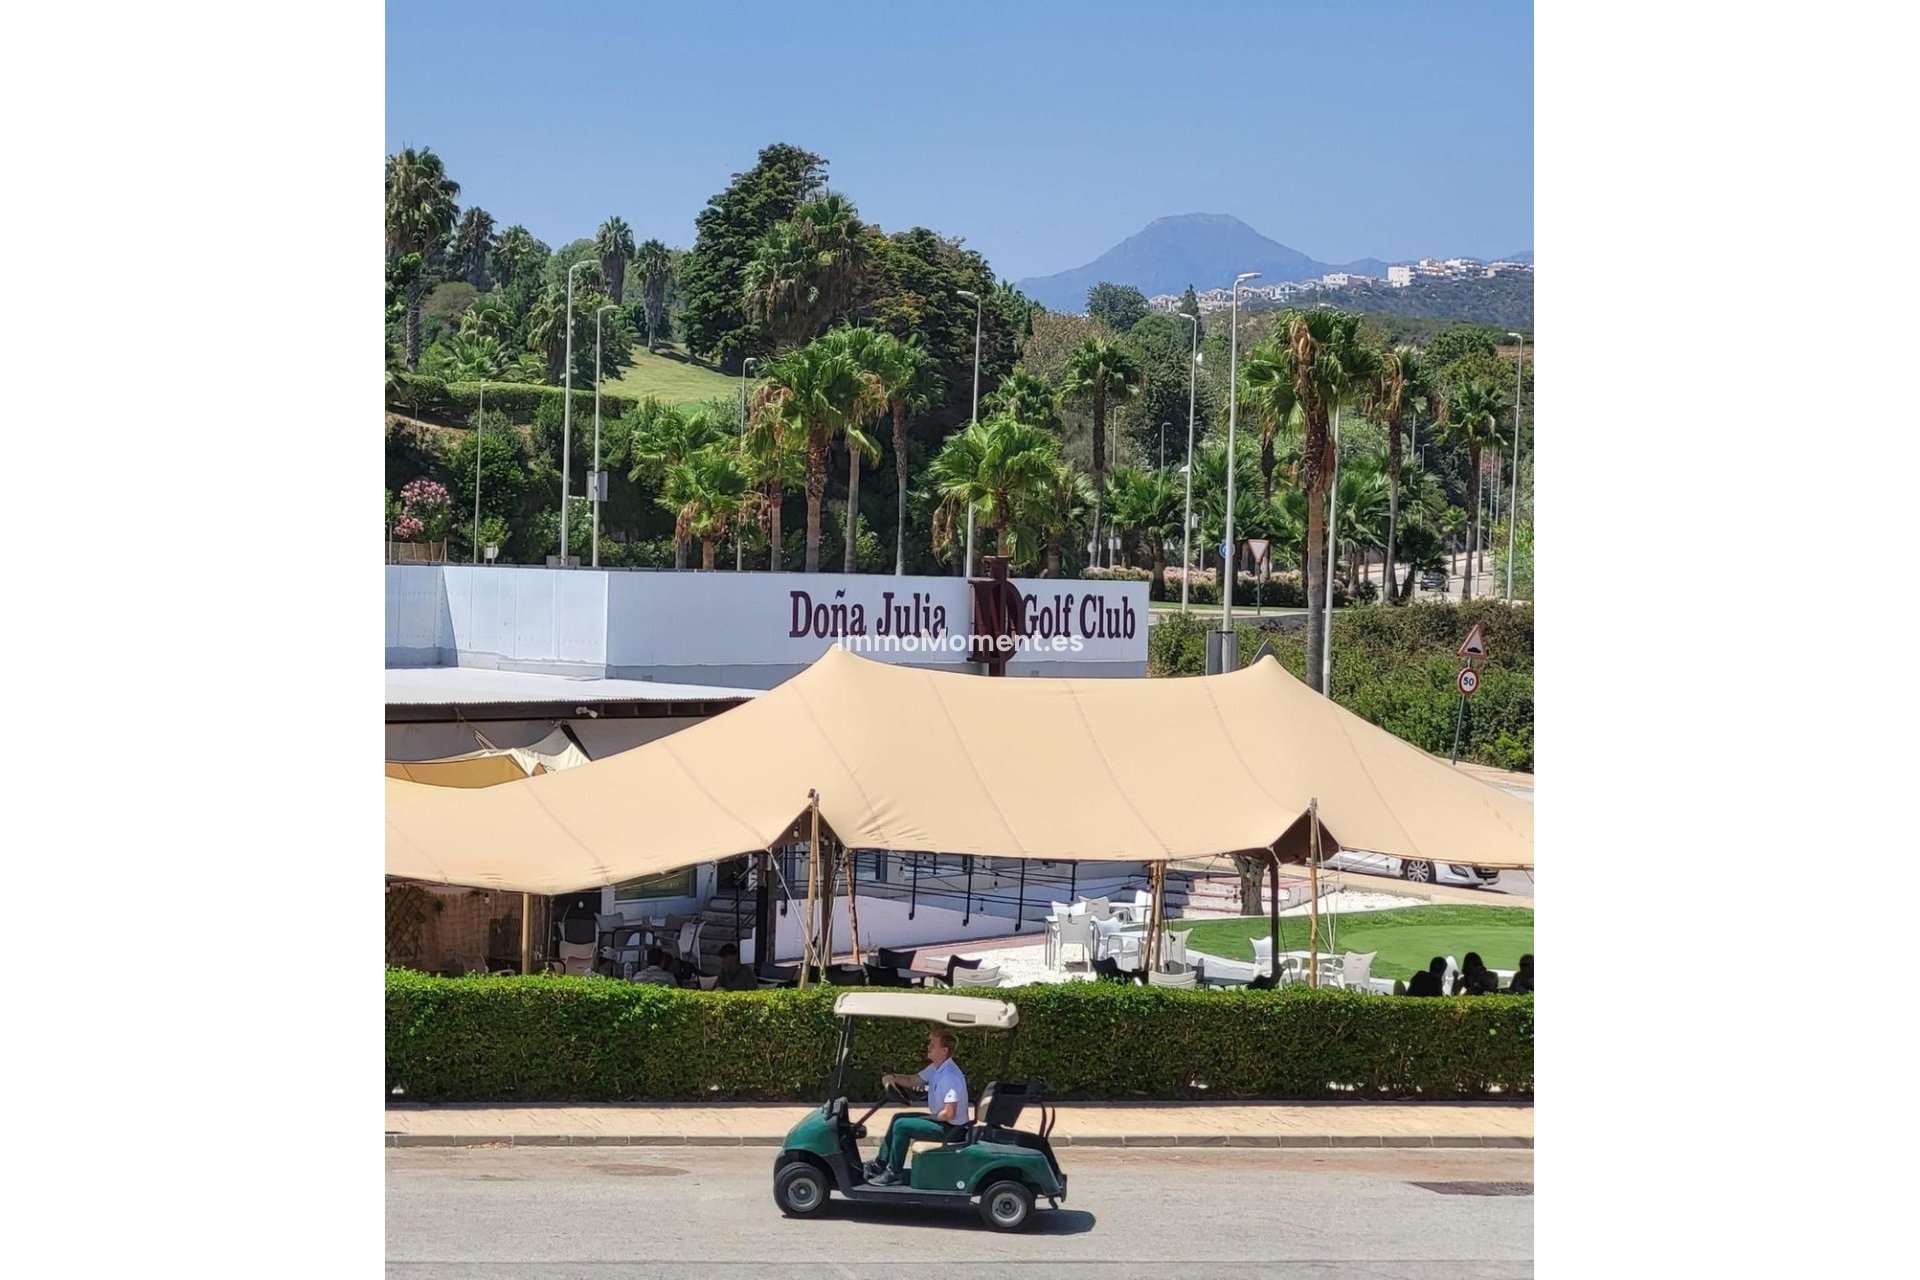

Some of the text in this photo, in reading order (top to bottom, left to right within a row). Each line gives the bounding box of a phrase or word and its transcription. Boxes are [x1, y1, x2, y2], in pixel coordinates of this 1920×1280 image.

[789, 588, 867, 638] Doña
[876, 592, 949, 639] Julia
[1022, 593, 1075, 639] Golf
[1079, 594, 1136, 639] Club
[1463, 677, 1475, 687] 50
